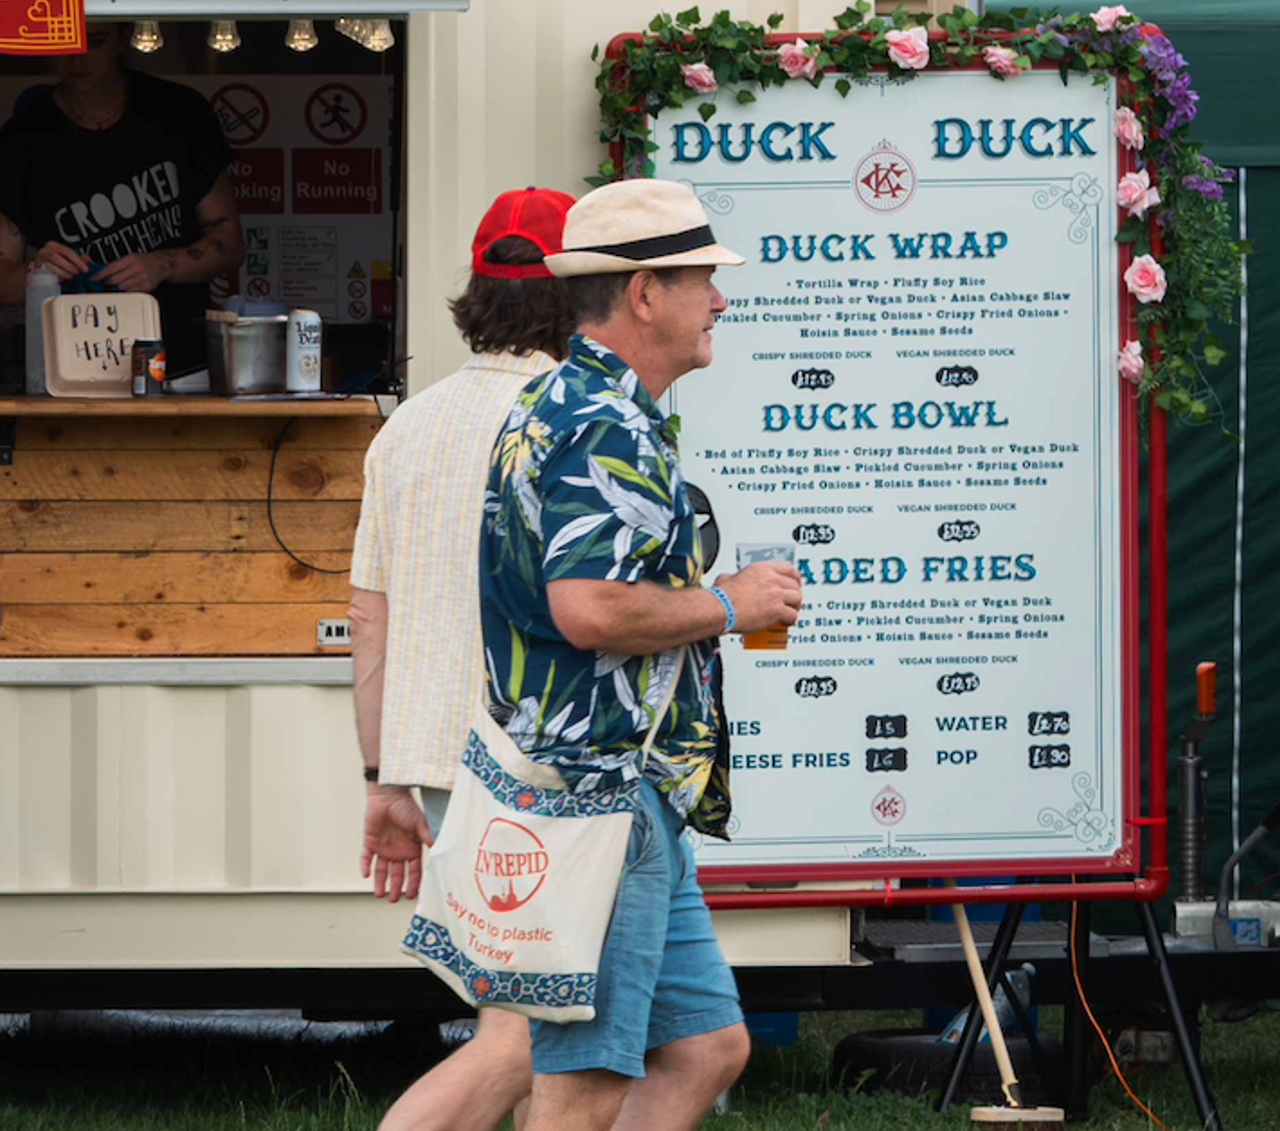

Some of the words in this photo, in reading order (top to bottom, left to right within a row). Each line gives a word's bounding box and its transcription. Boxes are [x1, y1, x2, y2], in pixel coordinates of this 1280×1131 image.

[669, 121, 836, 163] DUCK
[932, 118, 1097, 159] DUCK
[323, 160, 350, 176] No
[55, 160, 180, 243] CROOKED
[296, 183, 377, 202] Running
[760, 234, 875, 262] DUCK
[887, 231, 1007, 259] WRAP
[800, 328, 838, 337] Hoisin
[843, 328, 877, 336] Sauce
[891, 327, 935, 336] Sesame
[939, 326, 973, 335] Seeds
[75, 338, 130, 366] HERE
[762, 403, 877, 431] DUCK
[891, 401, 1008, 429] BOWL
[720, 466, 755, 474] Asian
[760, 465, 809, 475] Cabbage
[813, 464, 841, 473] Slaw
[855, 463, 899, 472] Pickled
[903, 462, 963, 471] Cucumber
[976, 461, 1017, 471] Spring
[1022, 460, 1063, 469] Onions
[737, 481, 776, 492] Crispy
[781, 481, 814, 490] Fried
[819, 480, 860, 489] Onions
[874, 479, 913, 488] Hoisin
[918, 478, 951, 487] Sauce
[965, 477, 1009, 486] Sesame
[1013, 476, 1047, 485] Seeds
[797, 557, 907, 584] ADED
[922, 554, 1036, 581] FRIES
[730, 721, 761, 736] IES
[935, 716, 1007, 731] WATER
[732, 754, 783, 769] EESE
[792, 752, 850, 767] FRIES
[936, 750, 977, 764] POP
[475, 848, 549, 877] INREPID
[468, 912, 485, 929] no
[502, 927, 553, 943] plastic
[468, 932, 514, 964] Turkey
